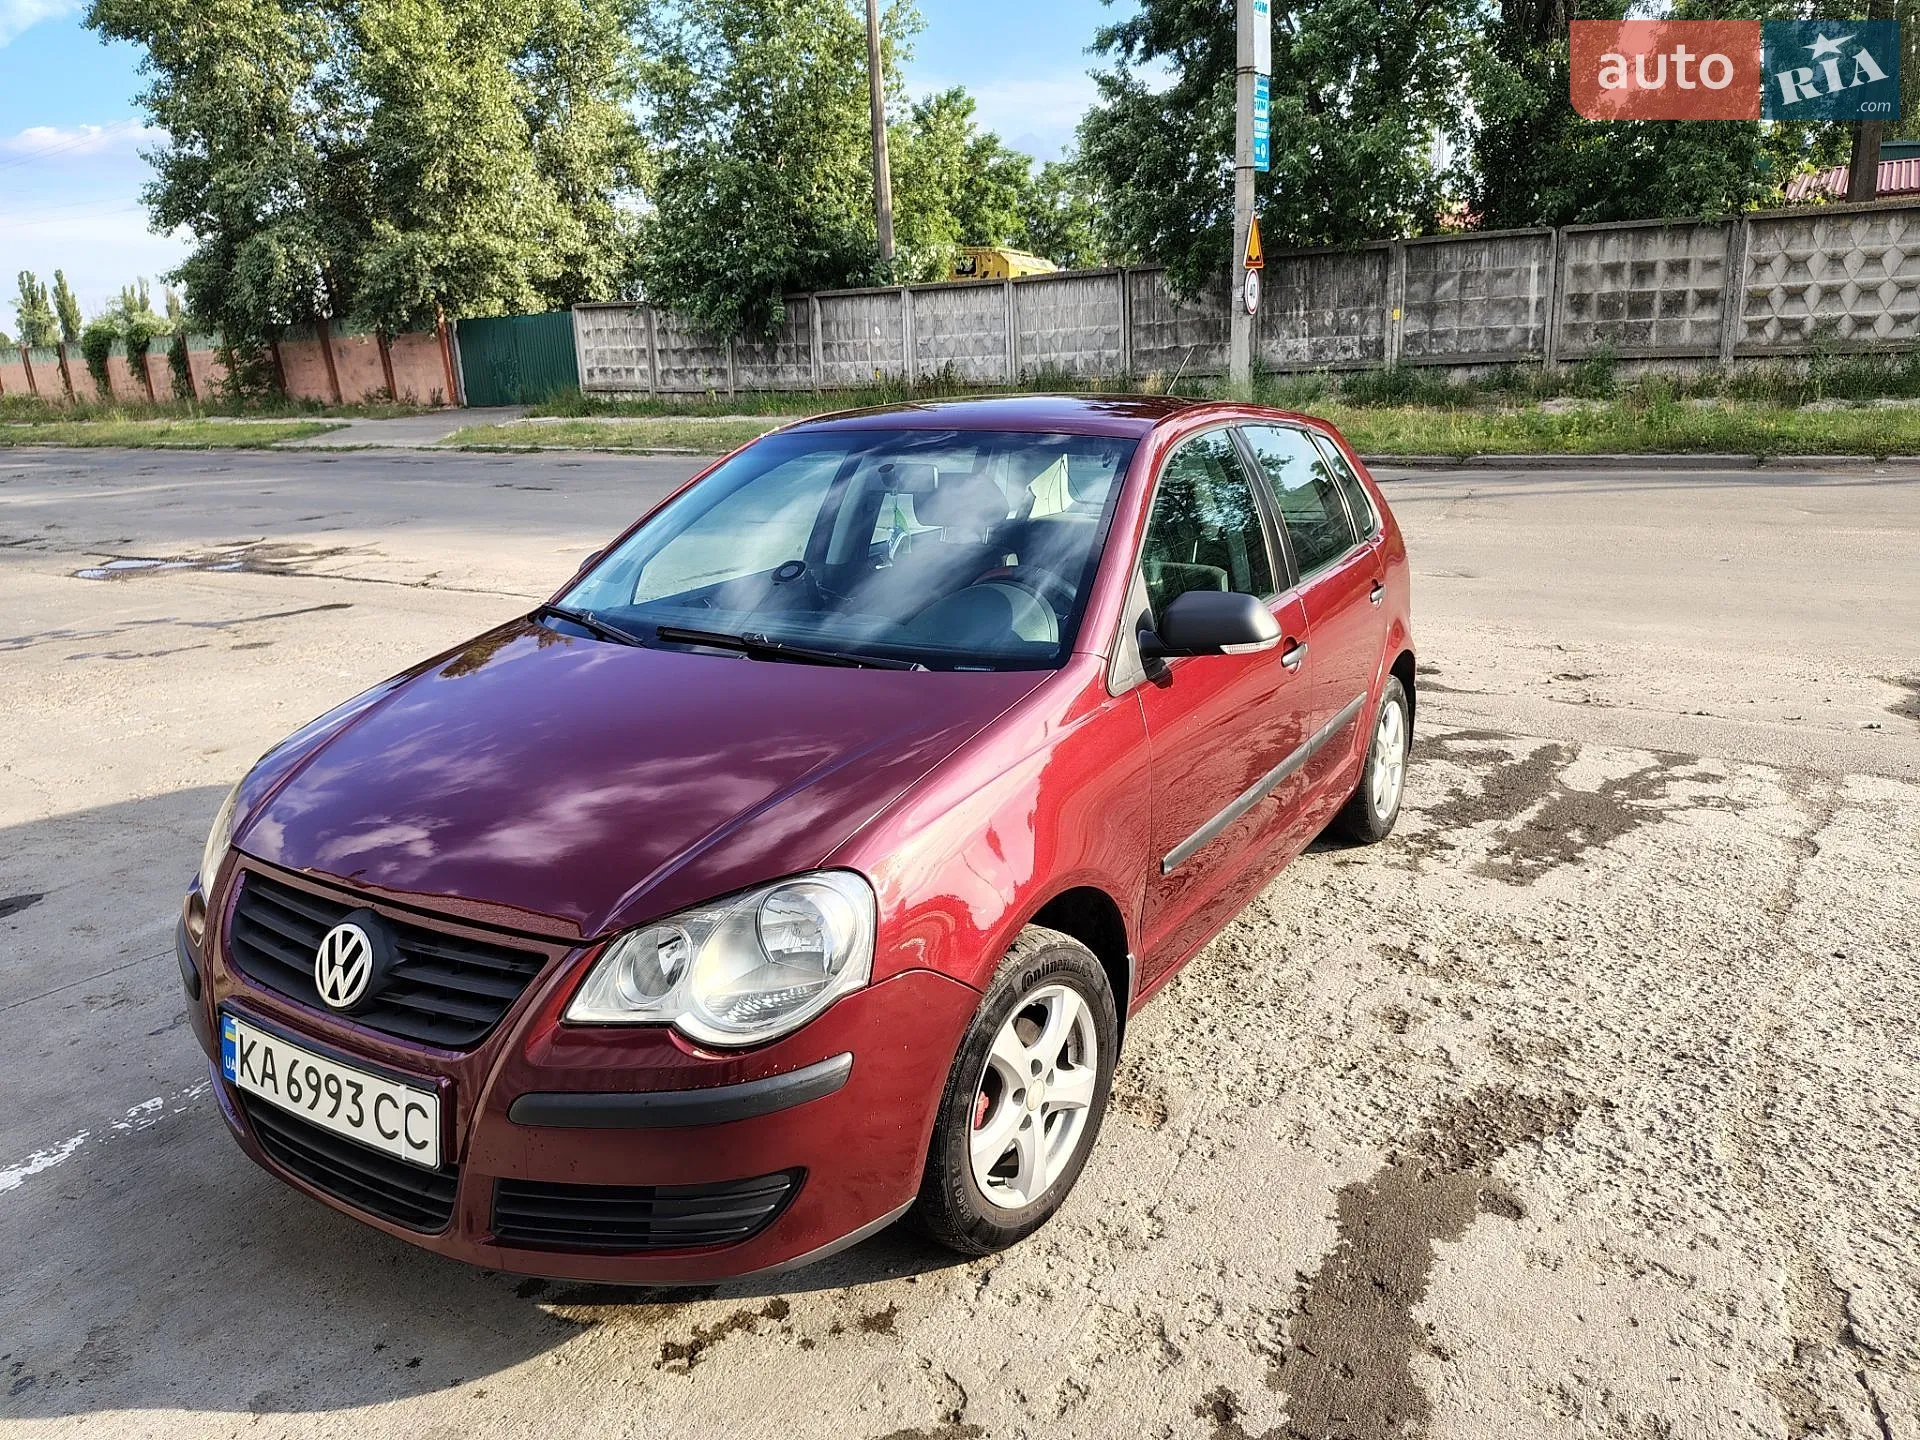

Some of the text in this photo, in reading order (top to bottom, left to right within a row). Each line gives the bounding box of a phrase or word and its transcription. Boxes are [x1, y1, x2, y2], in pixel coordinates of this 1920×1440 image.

[318, 925, 370, 1006] VW
[225, 1055, 235, 1070] UA
[239, 1033, 429, 1150] KA 6993 CC
